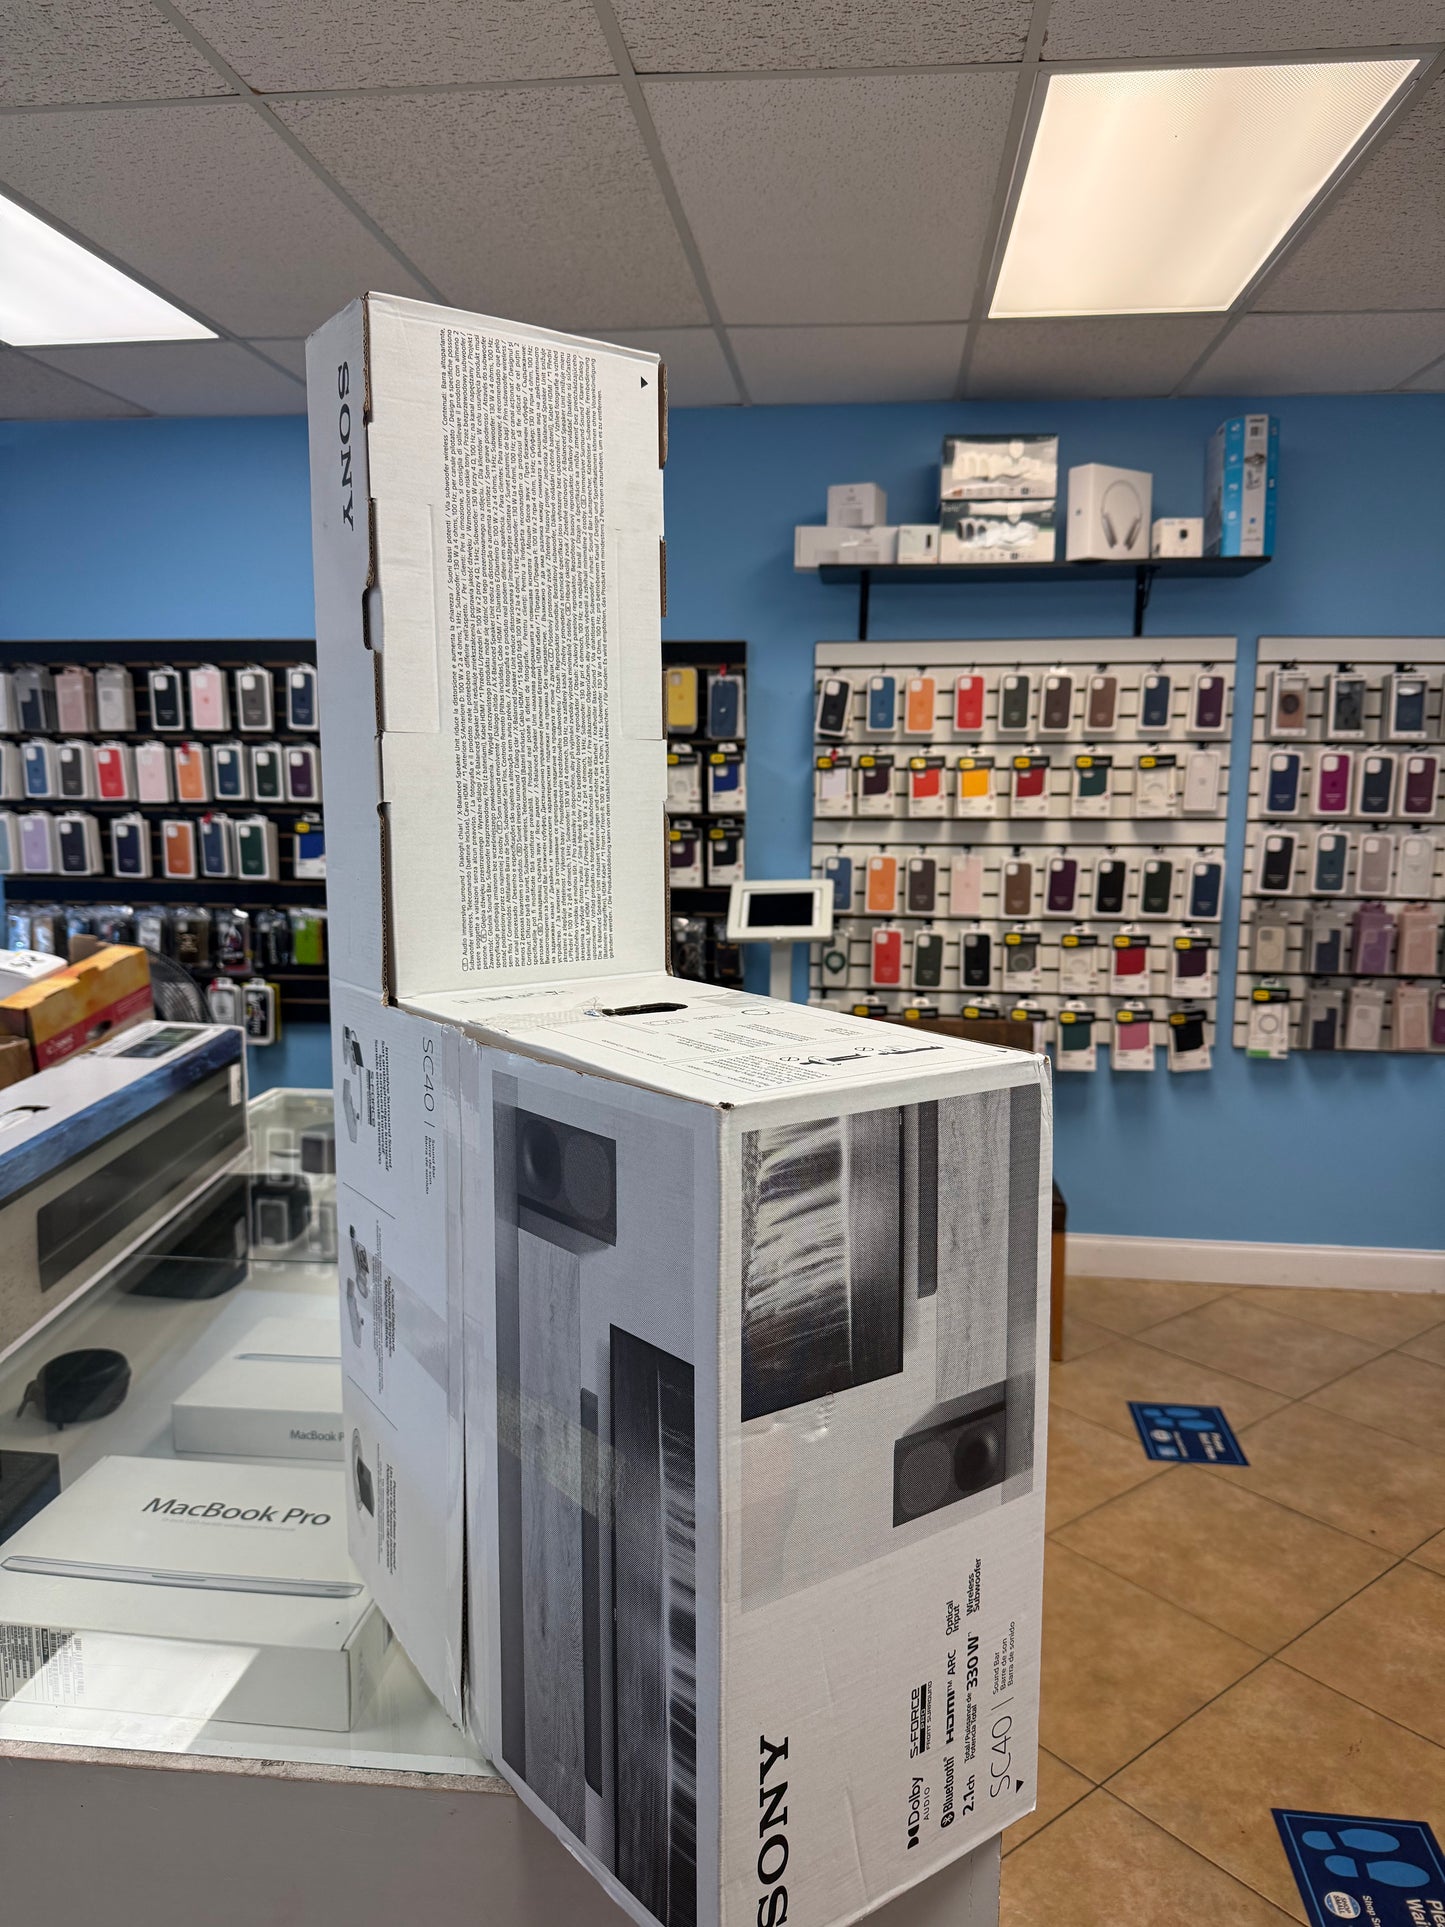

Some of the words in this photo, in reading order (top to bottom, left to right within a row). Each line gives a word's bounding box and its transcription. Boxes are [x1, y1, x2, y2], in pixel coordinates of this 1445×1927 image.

[337, 361, 354, 532] SONY
[461, 603, 469, 641] nell'aspetto.
[423, 1037, 434, 1111] SC40
[290, 1429, 337, 1441] MacBook
[141, 1497, 280, 1522] MacBook
[281, 1507, 332, 1526] Pro
[966, 1573, 974, 1616] Wireless
[973, 1558, 981, 1612] Subwoofer
[946, 1600, 954, 1636] Optical
[953, 1604, 961, 1632] Input
[947, 1649, 956, 1675] ARC
[966, 1656, 978, 1691] 330
[1001, 1655, 1007, 1666] de
[1008, 1651, 1014, 1662] de
[966, 1692, 972, 1703] de
[992, 1667, 1000, 1695] Sound
[910, 1687, 919, 1759] S-FORCE
[990, 1715, 1012, 1798] SC40
[908, 1777, 923, 1826] Dolby
[963, 1774, 975, 1816] 2.1ch
[757, 1734, 790, 1927] SONY
[1362, 1895, 1376, 1916] Shop
[1405, 1899, 1432, 1927] Wai
